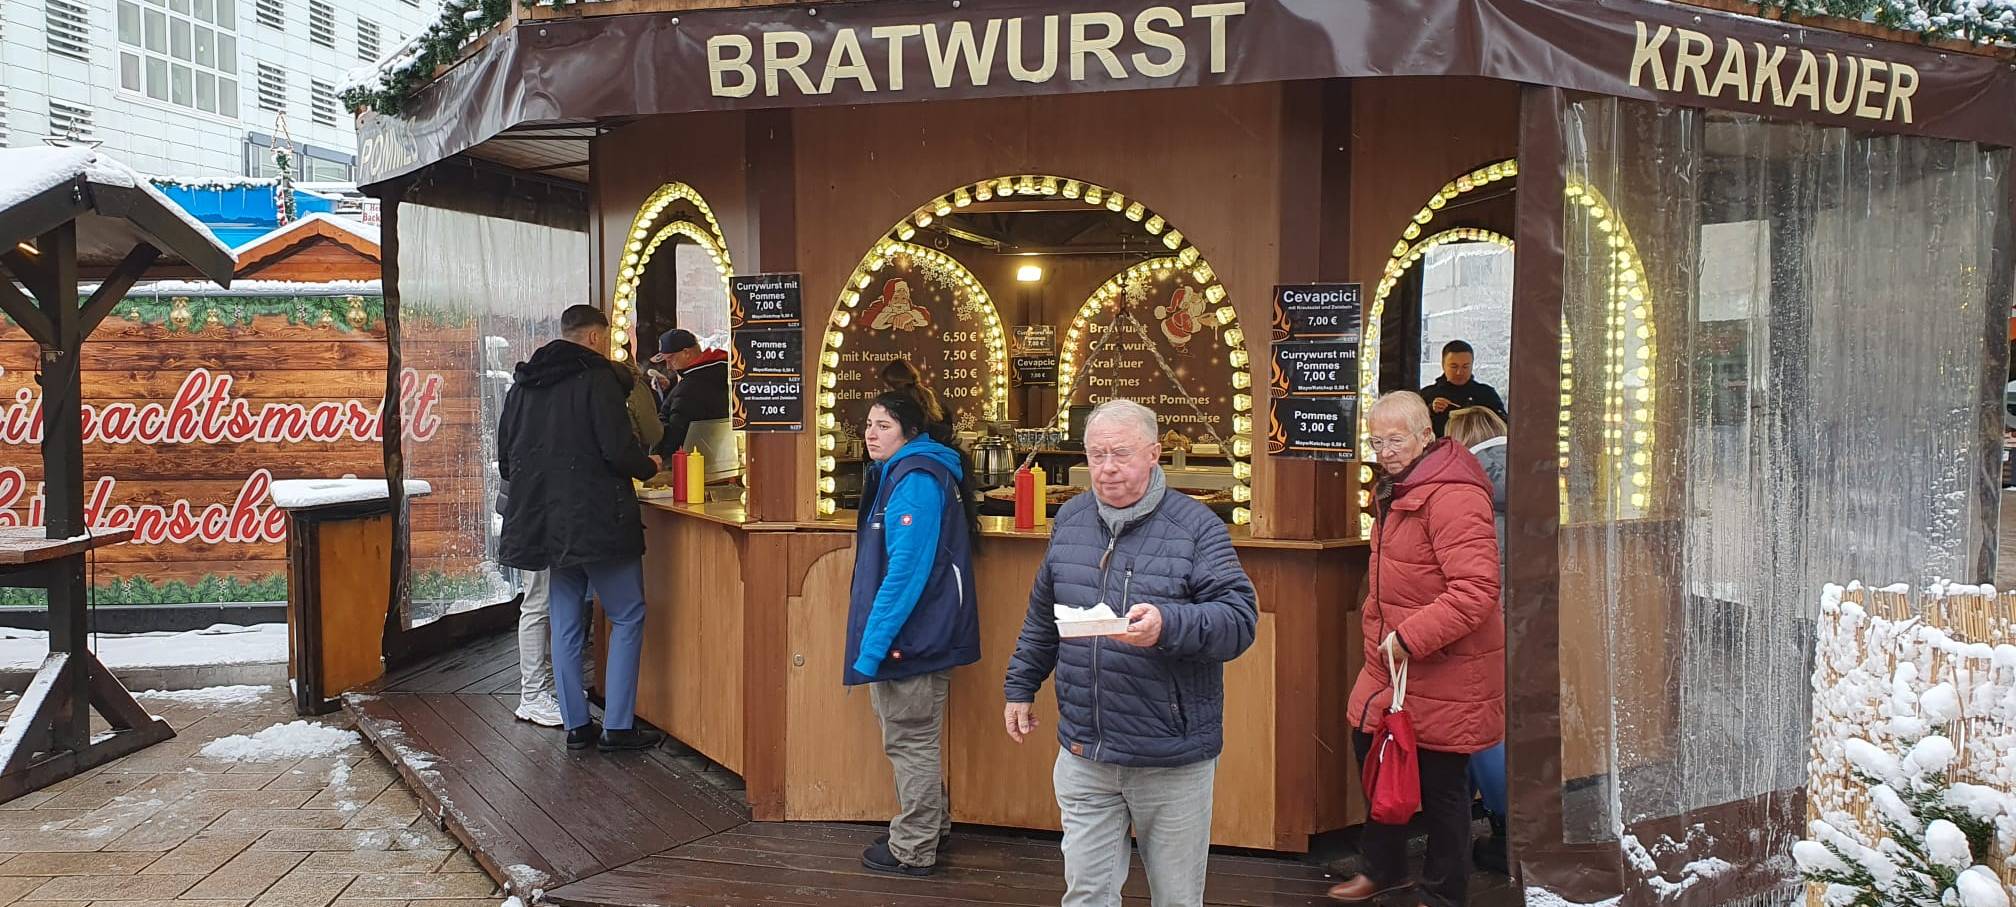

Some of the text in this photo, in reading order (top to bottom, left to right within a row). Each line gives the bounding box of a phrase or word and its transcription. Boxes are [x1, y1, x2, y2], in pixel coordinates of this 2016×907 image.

[707, 2, 1245, 98] BRATWURST
[1629, 20, 1920, 124] KRAKAUER
[736, 281, 798, 292] Currywurst mit
[749, 292, 785, 300] Pommes
[1283, 289, 1356, 305] Cevapcici
[755, 301, 783, 311] 7,00 €
[1308, 316, 1338, 326] 7,00 €
[943, 332, 977, 343] 6,50 €
[751, 340, 787, 349] Pommes
[756, 350, 785, 360] 3,00 €
[842, 351, 860, 361] mit
[943, 350, 967, 361] 7,50
[969, 350, 977, 360] €
[1281, 349, 1356, 361] Currywurst mit
[1296, 361, 1340, 370] Pommes
[943, 369, 967, 380] 3,50
[969, 369, 977, 379] €
[1304, 371, 1336, 382] 7,00 €
[740, 382, 800, 396] Cevapcici
[943, 387, 967, 398] 4,00
[970, 387, 977, 397] €
[761, 406, 786, 415] 7,00 €
[1294, 411, 1338, 421] Pommes
[1157, 413, 1220, 425] ayonnaise
[1300, 422, 1335, 433] 3,00 €
